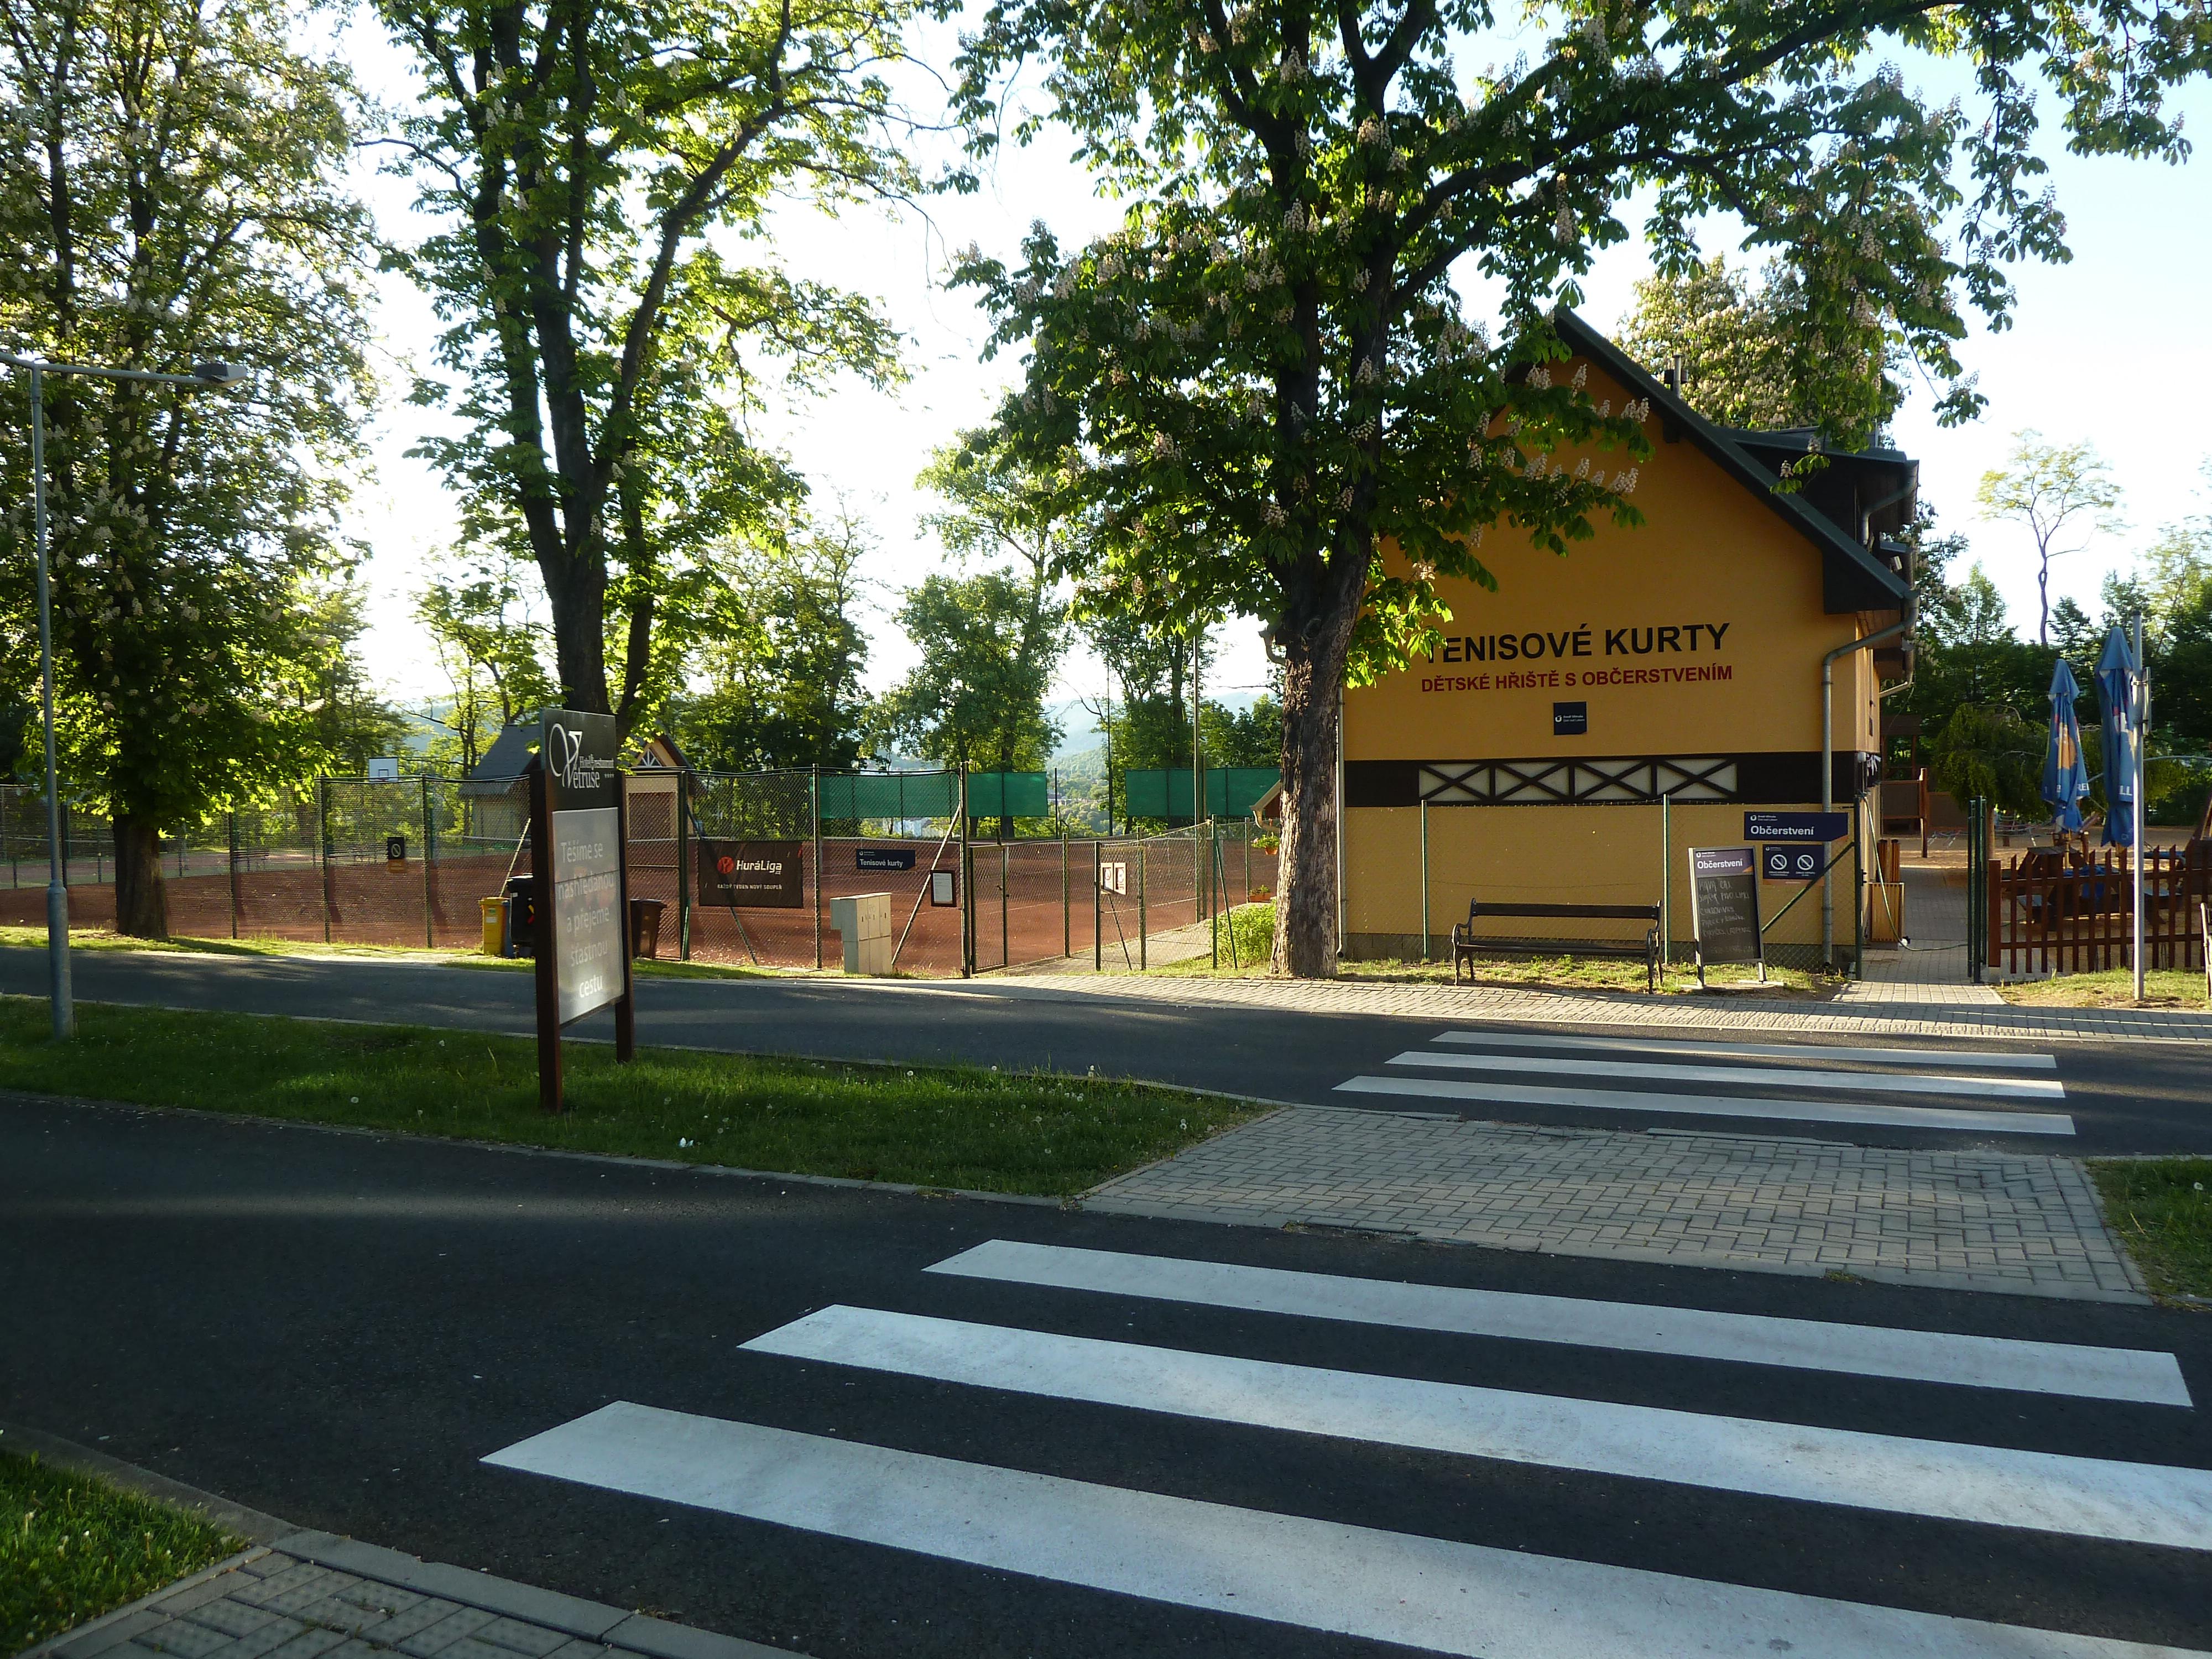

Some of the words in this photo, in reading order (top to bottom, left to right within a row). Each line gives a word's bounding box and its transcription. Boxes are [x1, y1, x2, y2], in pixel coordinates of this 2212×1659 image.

[1605, 623, 1730, 656] KURTY
[1421, 672, 1490, 692] DĚTSKÉ
[1495, 670, 1559, 689] HŘIŠTĚ
[1565, 672, 1577, 686] S
[1582, 662, 1733, 686] OBČERSTVENÍM
[1750, 826, 1814, 836] Občerstvení
[560, 839, 592, 863] Těšíme
[594, 842, 603, 859] se
[736, 860, 782, 873] HuráLiga
[887, 859, 903, 868] kurty
[1697, 858, 1743, 869] Občerstvení
[558, 870, 615, 900] nashledanou
[566, 917, 572, 934] a
[574, 906, 609, 937] přejeme
[579, 974, 603, 998] cestu
